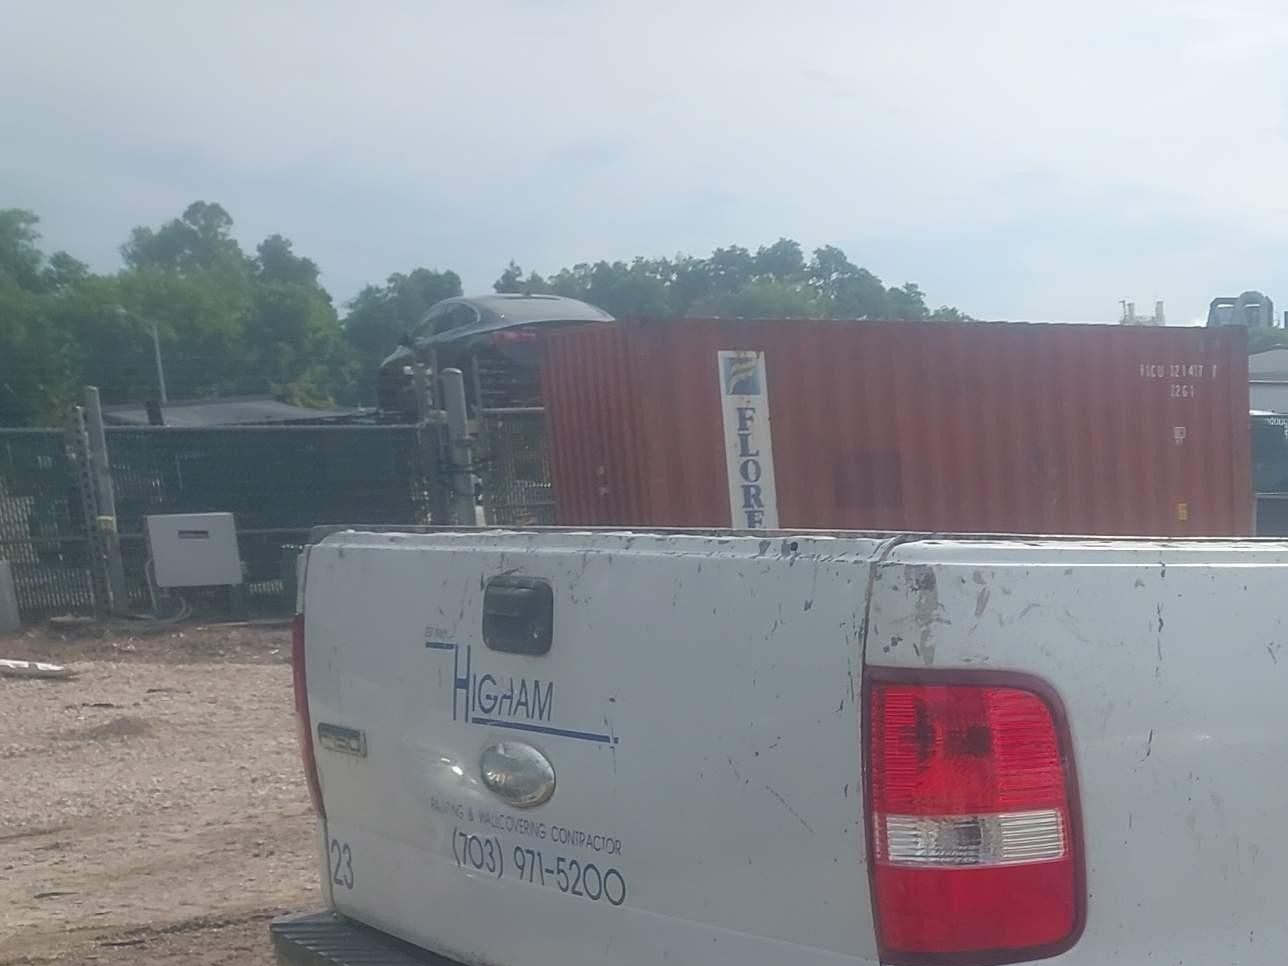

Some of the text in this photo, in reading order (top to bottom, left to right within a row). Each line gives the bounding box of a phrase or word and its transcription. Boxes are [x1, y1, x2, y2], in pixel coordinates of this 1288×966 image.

[453, 644, 554, 722] HIGHAM
[330, 838, 355, 890] 23
[453, 826, 627, 906] (703) 971-5200
[550, 826, 622, 856] CONTRACTOR
